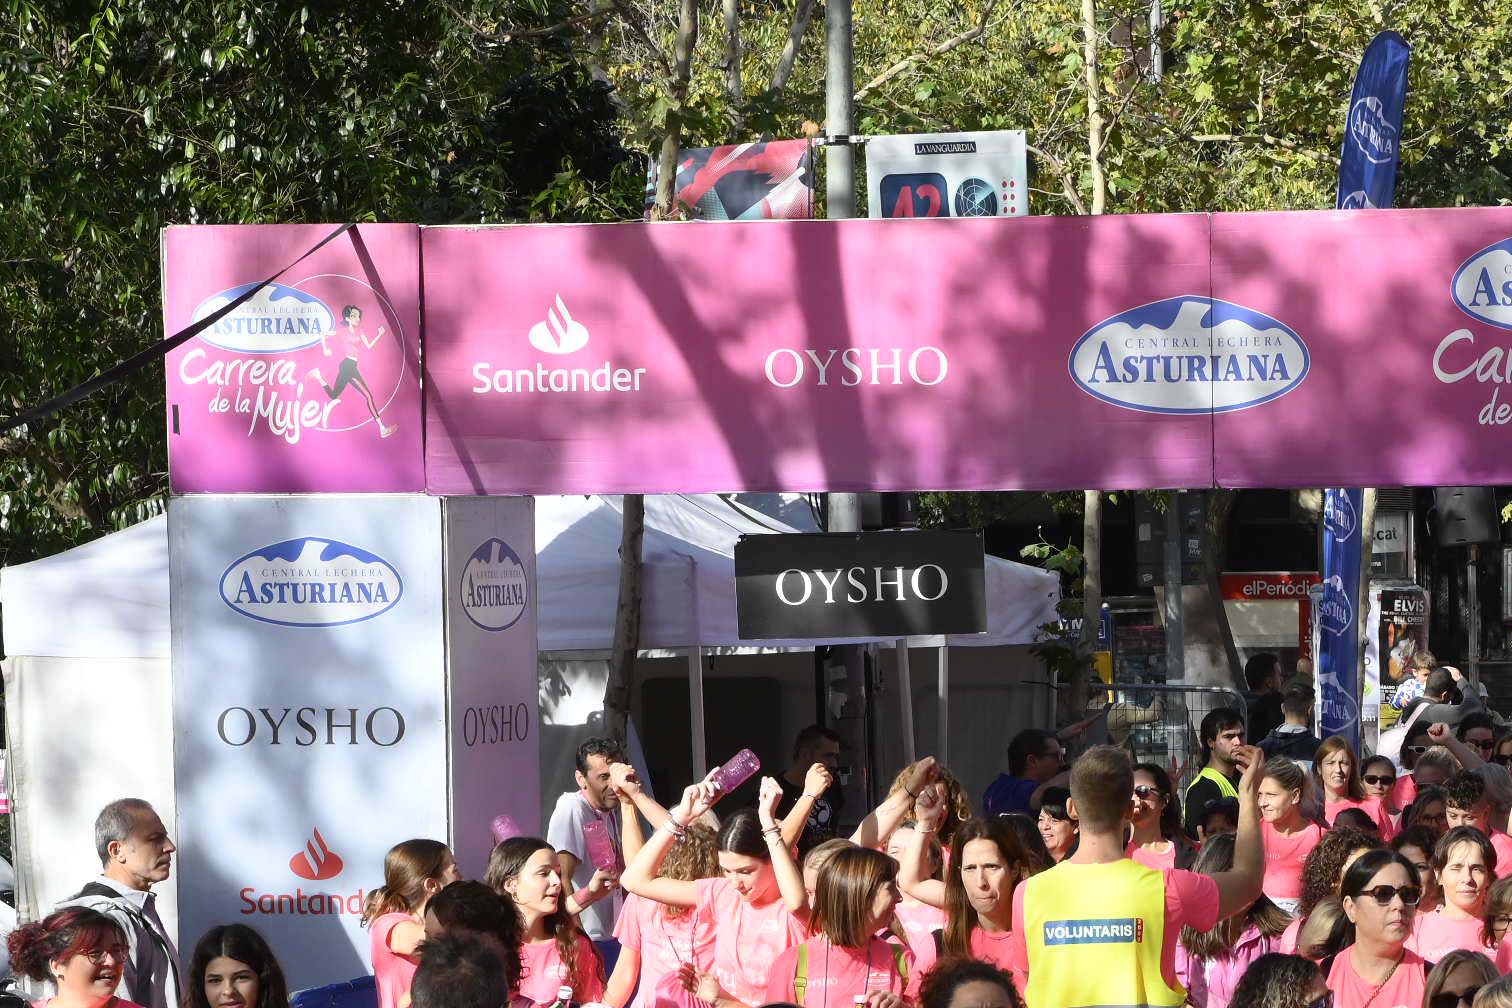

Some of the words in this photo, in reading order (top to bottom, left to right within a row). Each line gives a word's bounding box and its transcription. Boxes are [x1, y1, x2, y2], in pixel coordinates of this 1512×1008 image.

[1125, 337, 1198, 350] CENTRAL
[1207, 336, 1283, 348] LECHERA
[179, 351, 297, 386] Carrera
[473, 362, 646, 394] Santander
[764, 346, 949, 388] OYSHO
[1087, 342, 1289, 384] ASTURIANA
[208, 387, 233, 413] de
[235, 387, 251, 413] la
[248, 385, 342, 442] Mujer
[1479, 398, 1512, 426] de
[234, 571, 390, 604] ASTURIANA
[262, 568, 320, 579] CENTRAL
[325, 567, 384, 578] LECHERA
[775, 564, 950, 606] OYSHO
[1243, 580, 1314, 597] elPeriódi
[466, 573, 524, 608] ASTURIANA
[1393, 600, 1424, 612] ELVIS
[217, 706, 407, 747] OYSHO
[464, 703, 529, 746] OYSHO
[239, 887, 363, 915] Santand
[1045, 925, 1132, 940] VOLUNTARIS
